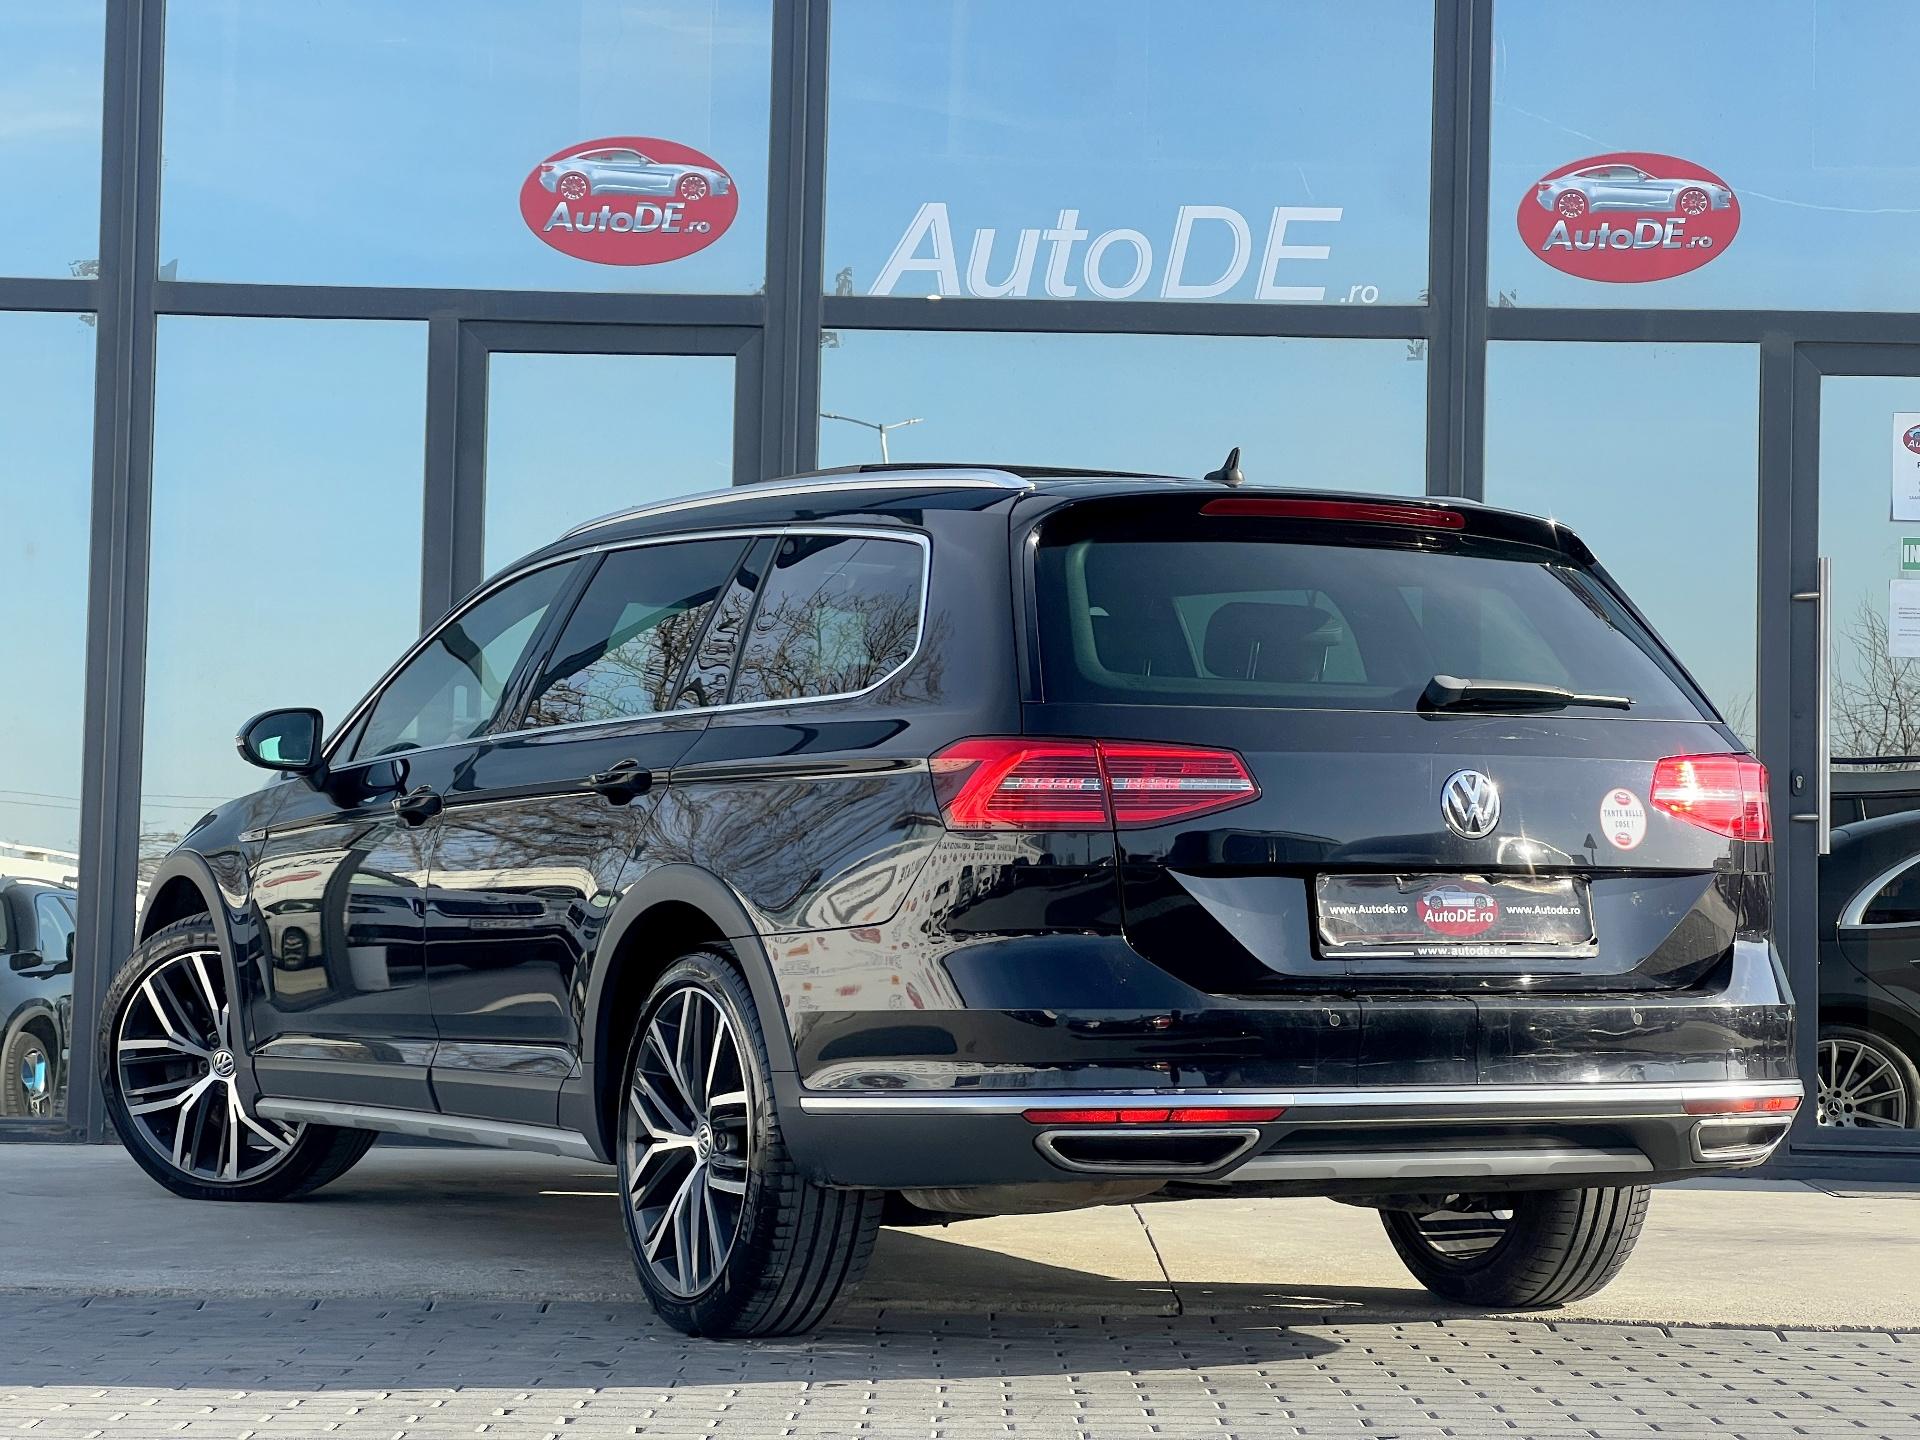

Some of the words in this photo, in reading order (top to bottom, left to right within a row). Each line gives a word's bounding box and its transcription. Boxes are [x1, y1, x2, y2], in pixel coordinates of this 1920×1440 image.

[1329, 904, 1408, 914] www.Autode.ro
[1506, 905, 1581, 915] www.Autode.ro
[1424, 909, 1494, 922] AutoDE.ro
[1418, 946, 1507, 956] www.autode.ro
